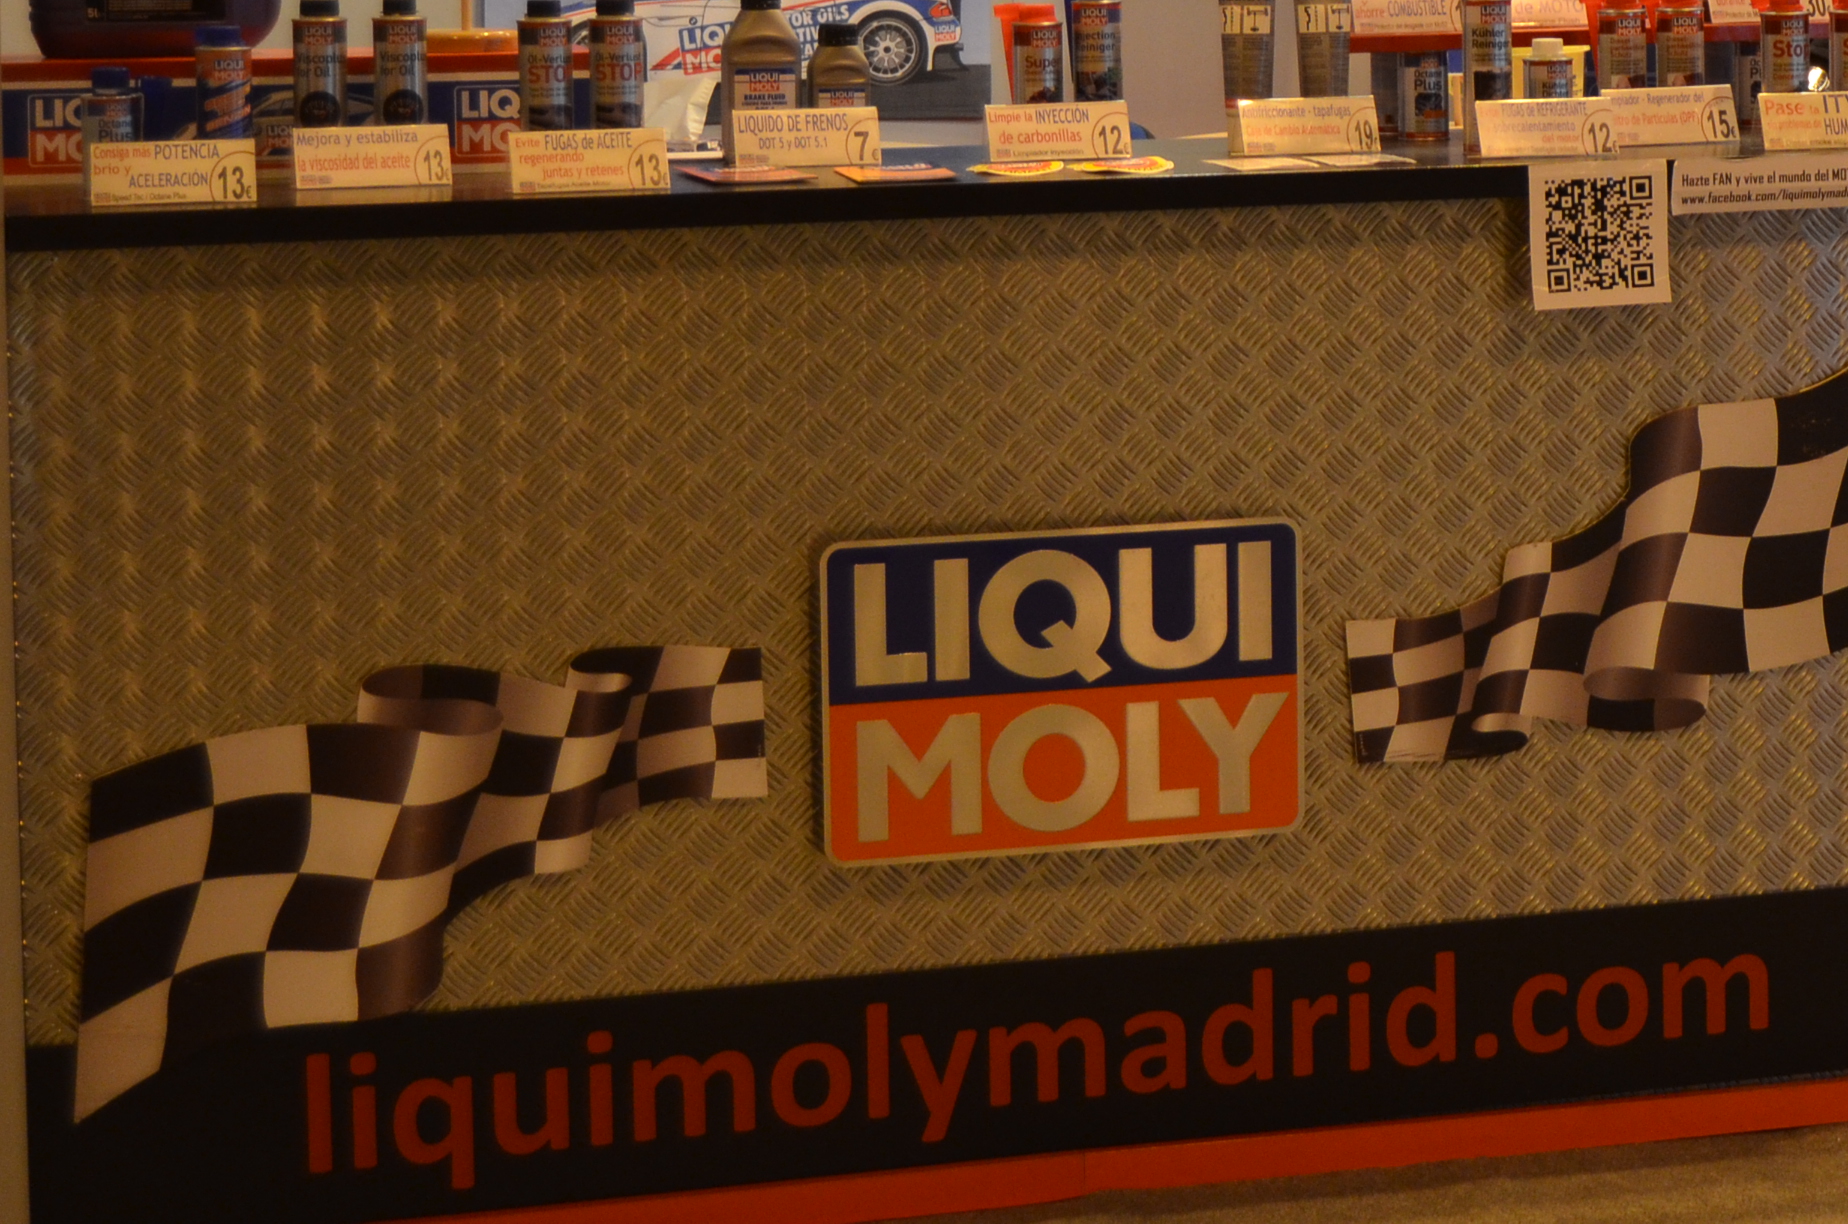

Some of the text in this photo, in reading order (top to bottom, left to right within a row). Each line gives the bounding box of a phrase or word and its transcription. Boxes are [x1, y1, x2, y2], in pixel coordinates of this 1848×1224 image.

[596, 63, 643, 81] STOP
[1764, 101, 1805, 116] Pase
[738, 113, 849, 133] LIQUIDO DE FRENOS
[515, 132, 632, 151] Evite FUGAS de ACEITE
[94, 147, 130, 161] Consiga
[154, 144, 220, 160] POTENCIA
[129, 169, 209, 188] ACELERACIÓN
[1682, 174, 1710, 187] Hazte
[1713, 173, 1732, 185] FAN
[1735, 176, 1741, 187] y
[1744, 171, 1764, 184] vive
[1767, 170, 1776, 183] el
[1779, 169, 1811, 183] mundo
[1815, 168, 1829, 181] del
[854, 540, 1273, 687] LIQUI
[856, 691, 1290, 843] MOLY
[305, 950, 1772, 1188] liquimolymadrid.com
